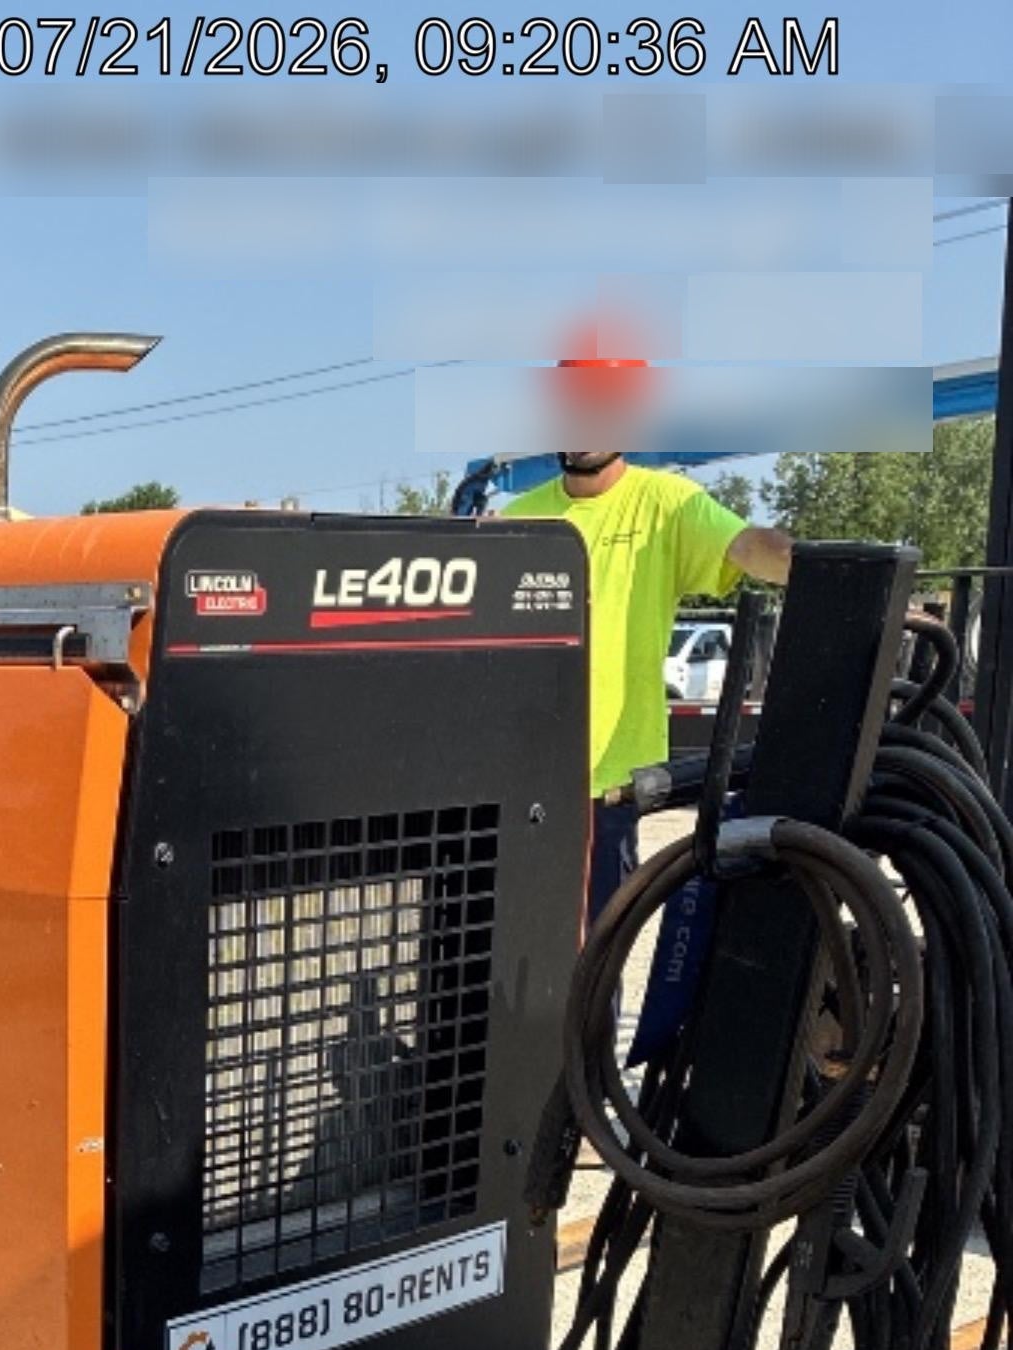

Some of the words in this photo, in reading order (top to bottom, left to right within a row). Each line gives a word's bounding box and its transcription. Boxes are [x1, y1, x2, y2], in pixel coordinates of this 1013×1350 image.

[190, 575, 252, 592] LINCOLN
[313, 557, 477, 606] LE400
[343, 1250, 490, 1324] 80-RENTS
